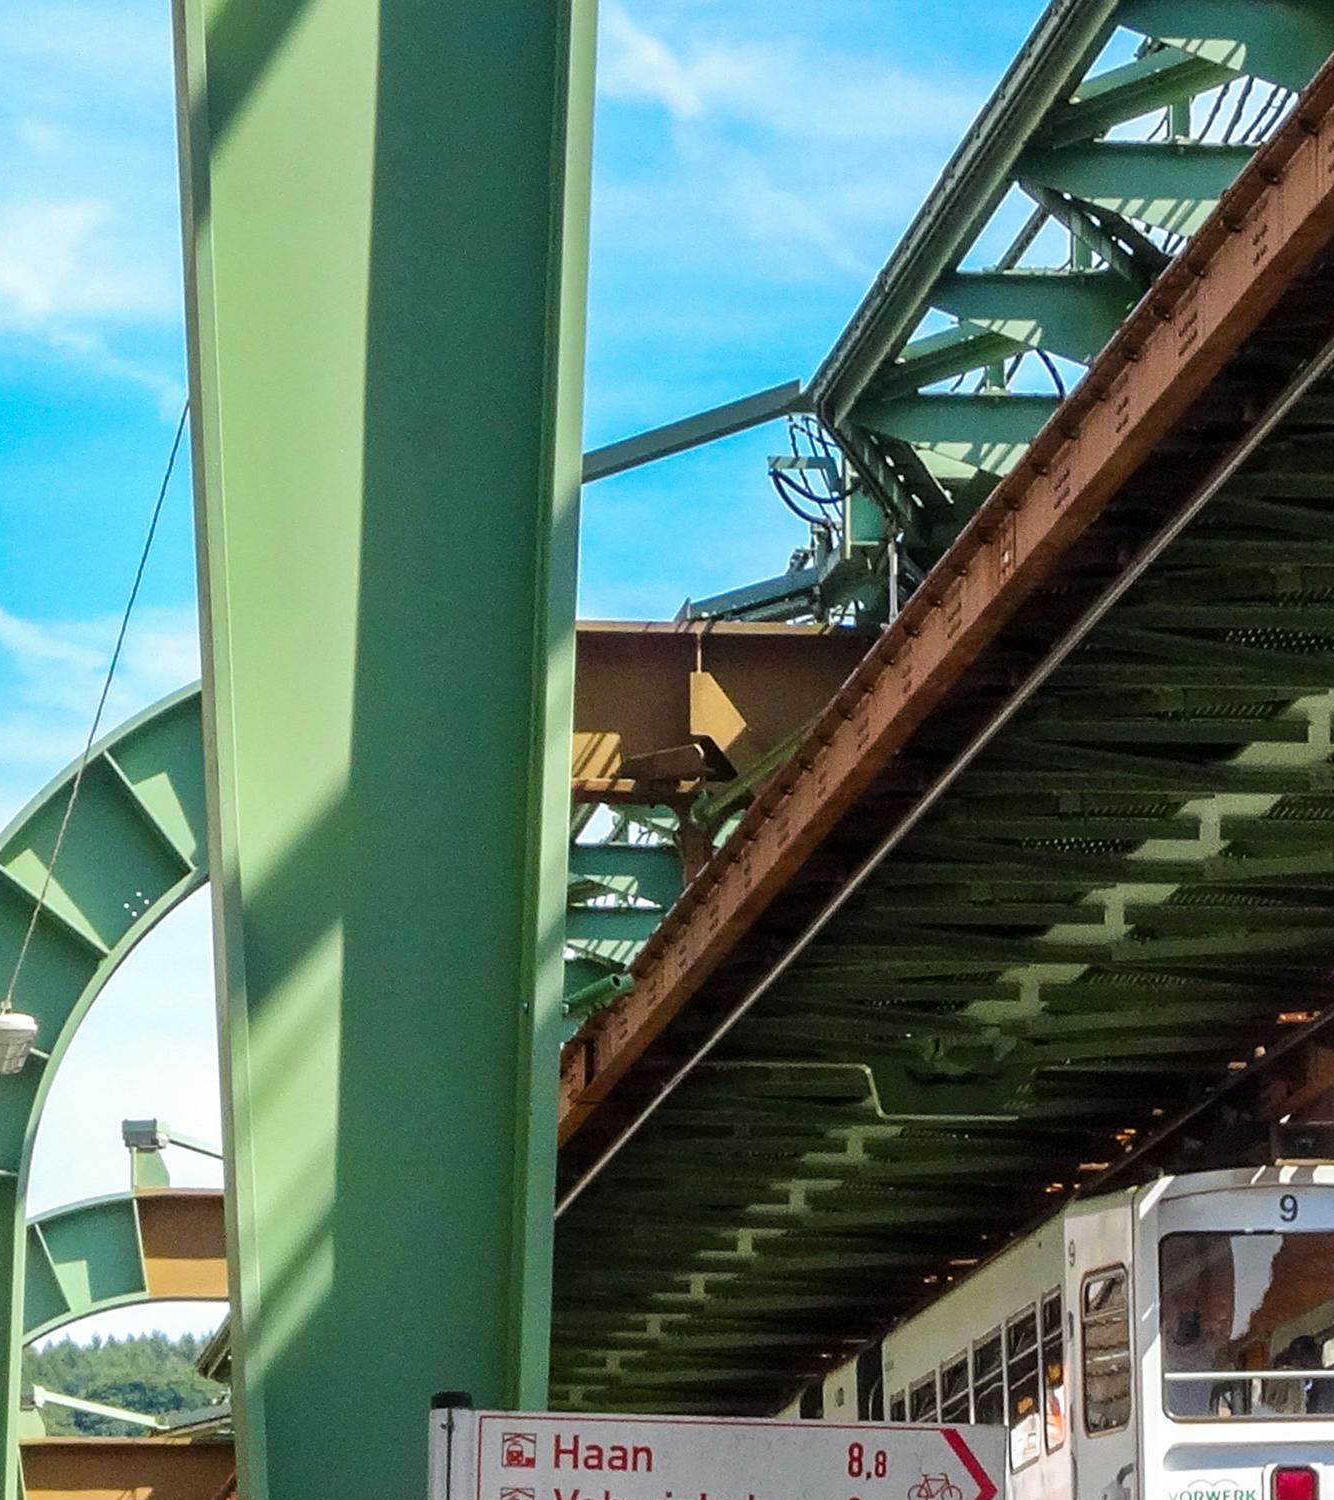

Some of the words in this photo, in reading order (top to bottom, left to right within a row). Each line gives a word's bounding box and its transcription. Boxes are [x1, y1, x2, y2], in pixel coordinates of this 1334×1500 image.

[1279, 1194, 1299, 1222] 9
[553, 1433, 653, 1472] Haan
[847, 1442, 888, 1480] 8,8
